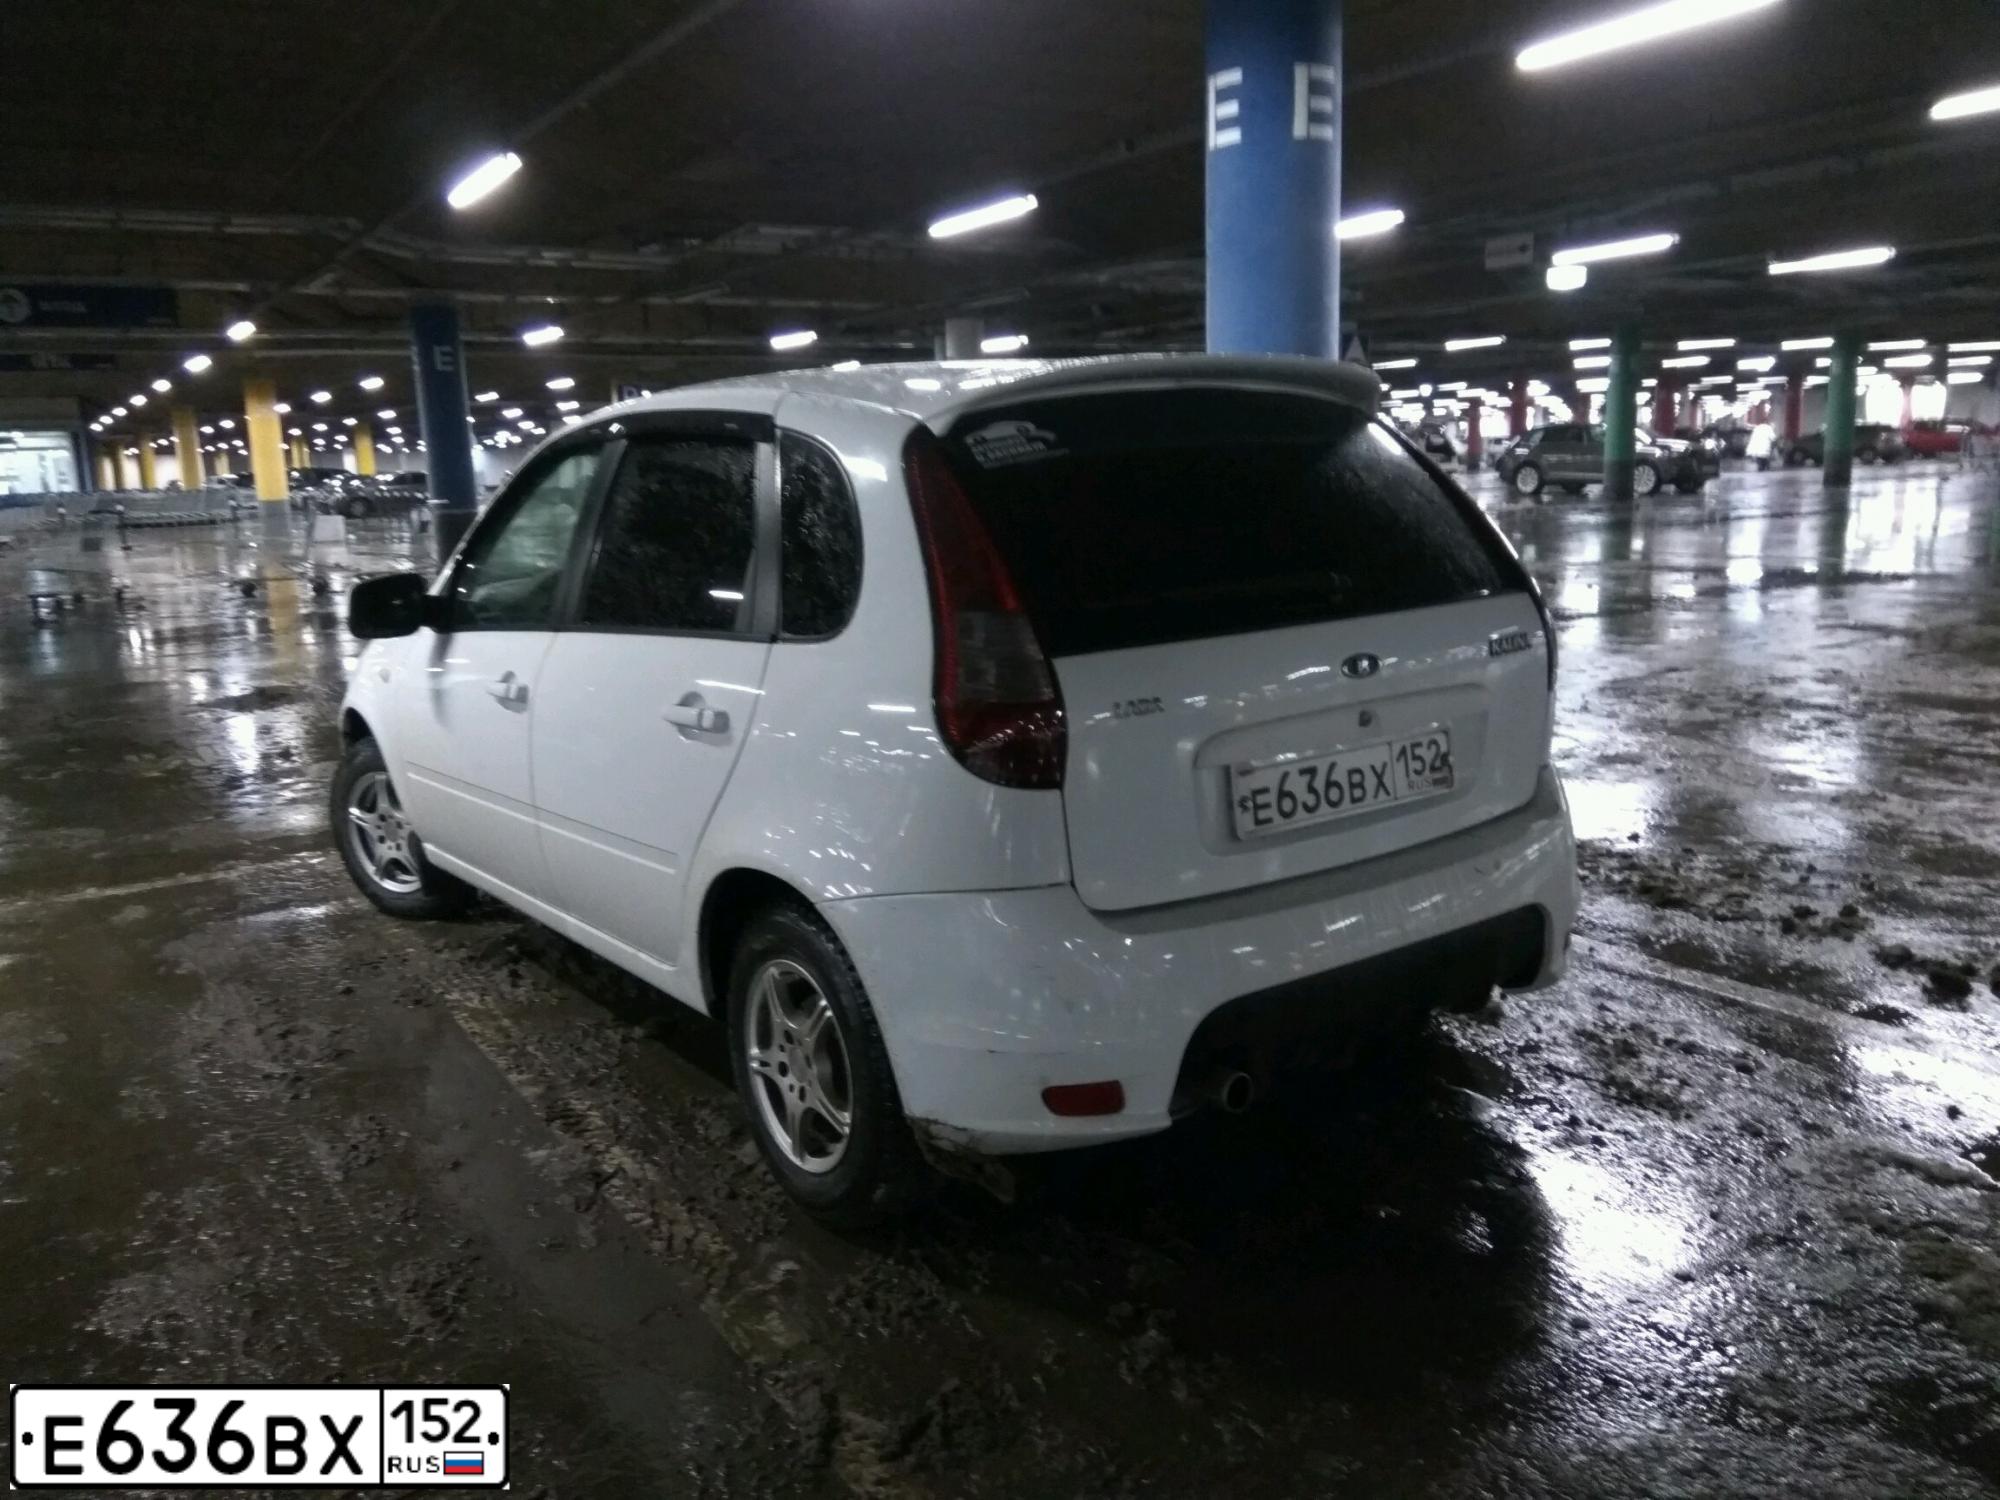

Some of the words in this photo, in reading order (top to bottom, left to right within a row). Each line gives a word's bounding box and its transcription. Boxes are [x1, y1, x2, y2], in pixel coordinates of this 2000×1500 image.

[1208, 66, 1242, 150] E
[1293, 62, 1335, 141] E
[433, 345, 454, 371] E
[1251, 761, 1391, 825] E636BX
[1396, 738, 1442, 779] 152
